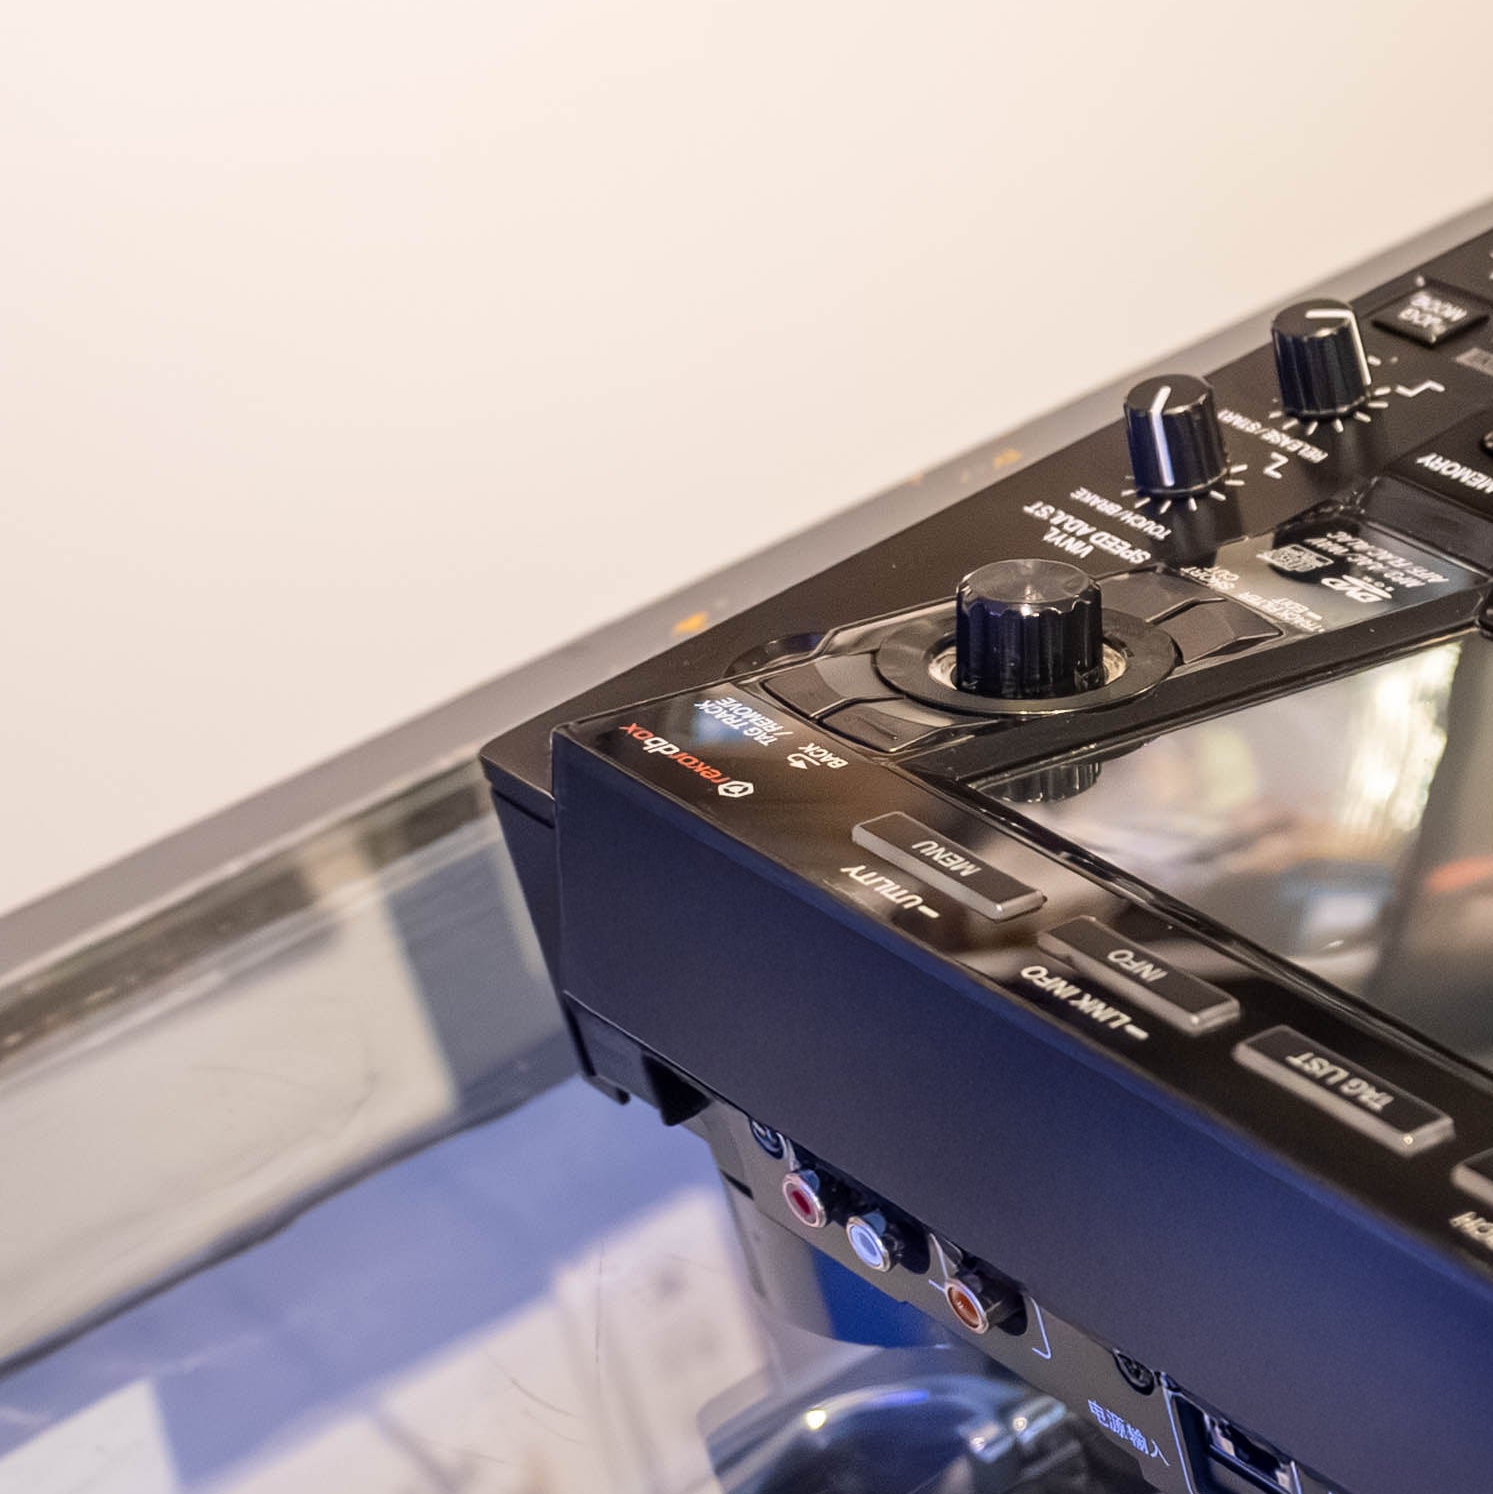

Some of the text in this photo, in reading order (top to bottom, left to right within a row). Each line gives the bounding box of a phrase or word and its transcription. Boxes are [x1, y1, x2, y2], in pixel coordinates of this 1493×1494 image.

[1070, 487, 1172, 541] TOUCH/BRAKE
[1090, 531, 1151, 565] SPEED
[693, 699, 780, 747] TAG TRACK
[619, 722, 732, 784] rekordbox
[798, 742, 849, 770] BACK
[911, 840, 982, 877] MENU
[840, 864, 924, 909] UTILITY
[1106, 948, 1168, 983] INFO
[1020, 964, 1132, 1029] LINK INFO
[1285, 1051, 1395, 1112] TAG LIST
